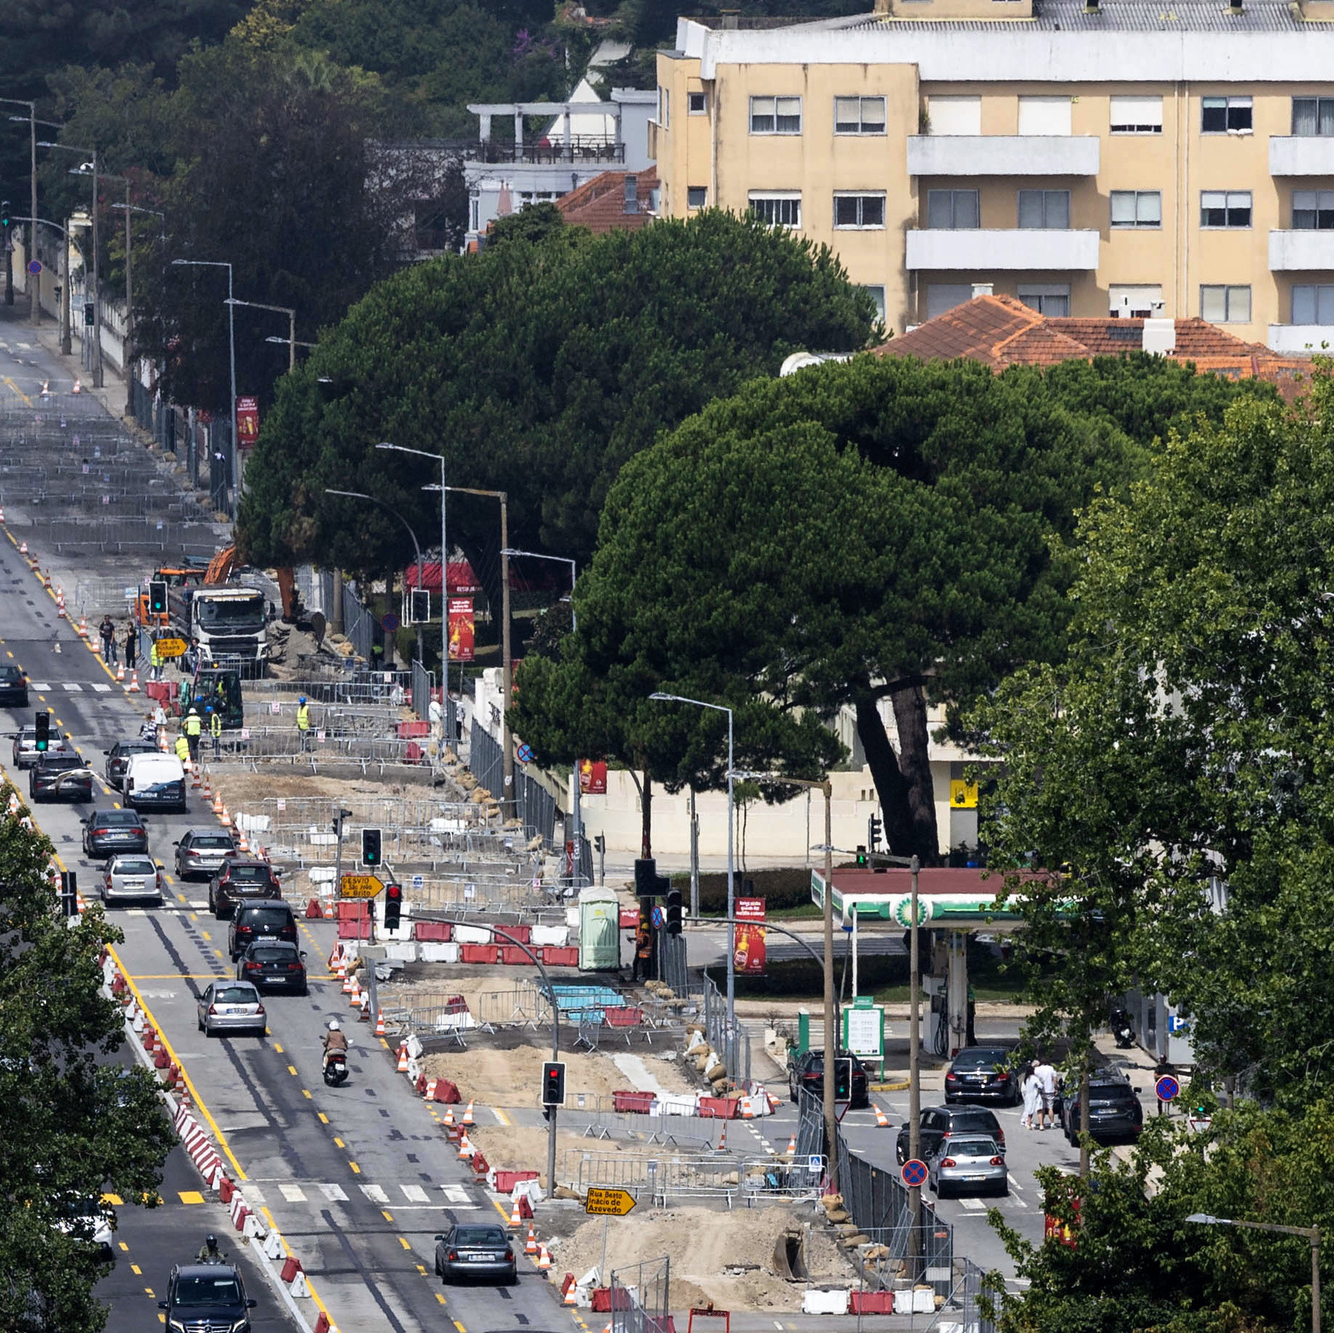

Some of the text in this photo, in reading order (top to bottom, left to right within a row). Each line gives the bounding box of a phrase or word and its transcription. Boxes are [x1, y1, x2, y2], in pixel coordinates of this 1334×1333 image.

[589, 1190, 603, 1198] Rua
[588, 1198, 610, 1206] Inácio
[588, 1204, 622, 1213] Azevedo
